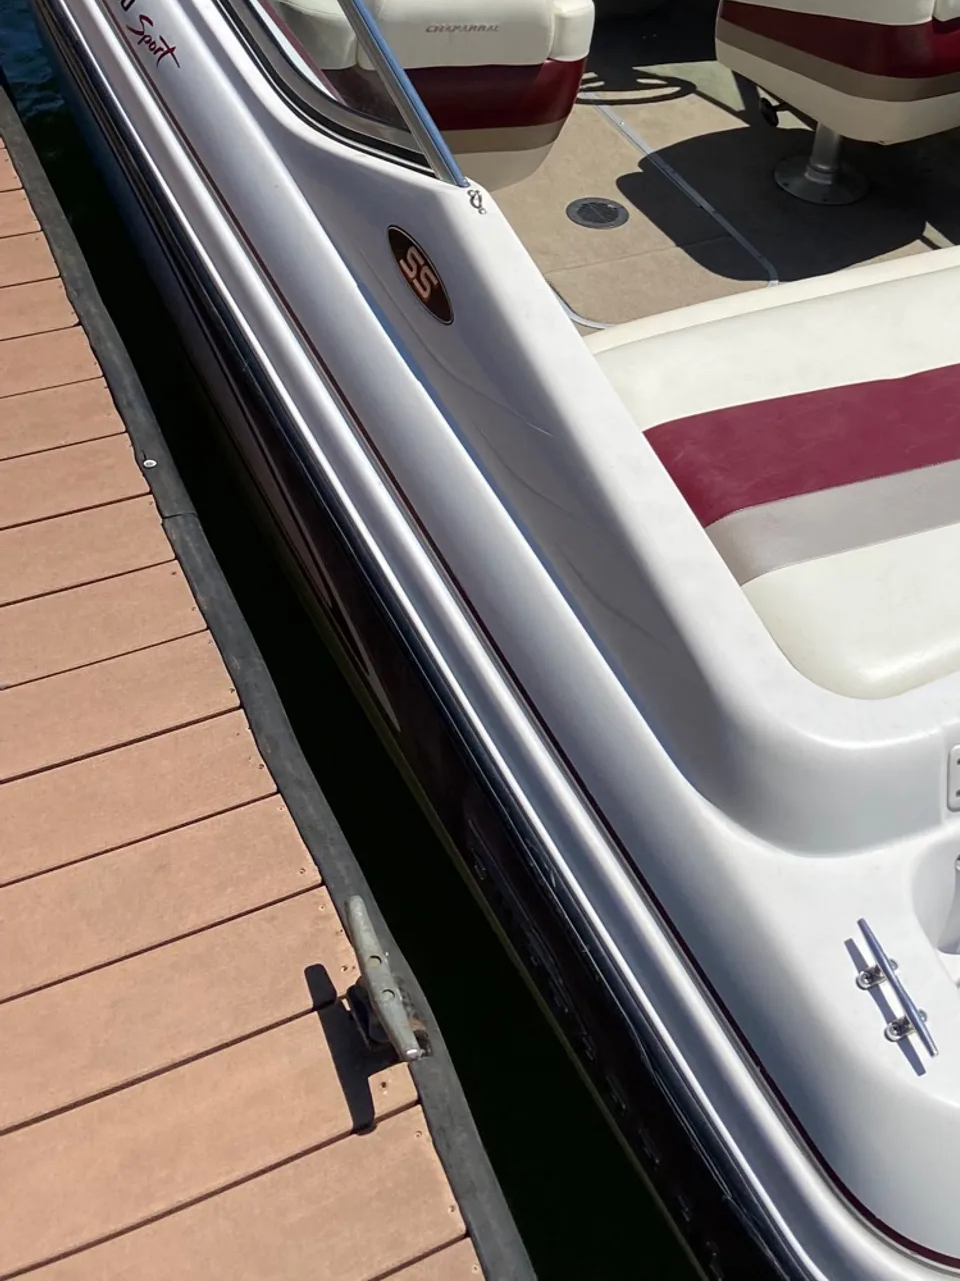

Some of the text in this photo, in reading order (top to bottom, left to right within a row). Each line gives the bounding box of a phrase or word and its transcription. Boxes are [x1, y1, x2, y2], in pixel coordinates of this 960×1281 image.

[126, 14, 180, 68] Sport
[425, 24, 499, 33] CHAPARRAL
[400, 246, 439, 299] SS
